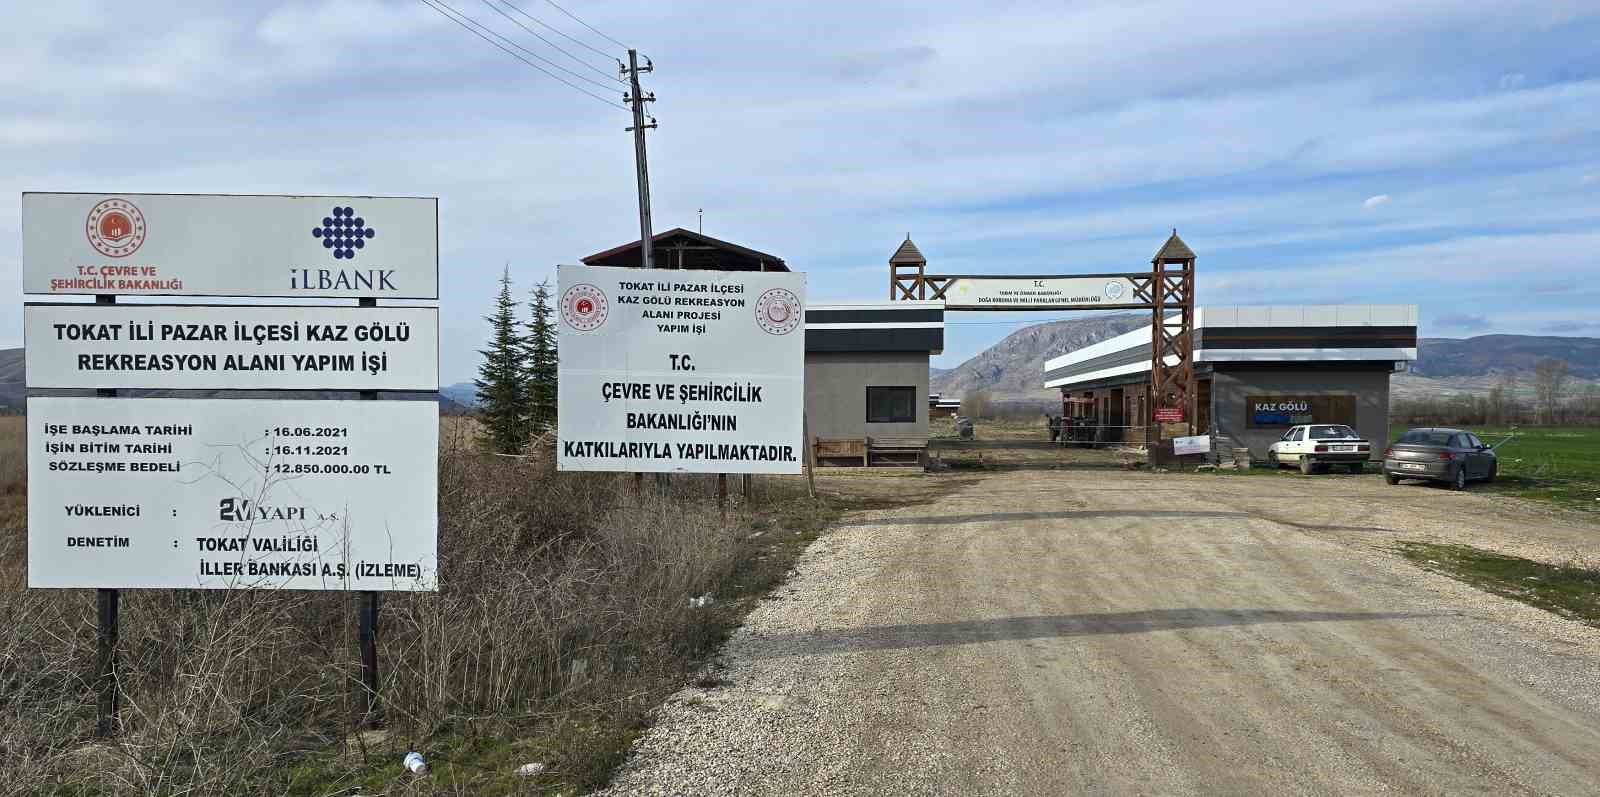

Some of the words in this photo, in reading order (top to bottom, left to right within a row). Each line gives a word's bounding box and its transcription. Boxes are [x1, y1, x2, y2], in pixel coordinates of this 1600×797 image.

[77, 266, 98, 276] T.C.
[100, 266, 138, 279] ÇEVRE
[140, 266, 156, 276] VE
[51, 277, 116, 291] ŞEHİRCİLİK
[119, 278, 183, 290] BAKANLIĞI
[619, 282, 654, 291] TOKAT
[658, 282, 670, 291] İLİ
[674, 284, 707, 292] PAZAR
[711, 283, 743, 295] İLÇESİ
[618, 296, 639, 304] KAZ
[643, 296, 671, 305] GÖLÜ
[675, 298, 744, 307] REKREASYON
[642, 310, 673, 318] ALANI
[677, 311, 720, 320] PROJESİ
[53, 324, 122, 340] TOKAT
[130, 321, 153, 340] İLİ
[161, 325, 227, 341] PAZAR
[235, 321, 299, 345] İLÇESİ
[307, 325, 348, 341] KAZ
[355, 322, 409, 341] GÖLÜ
[657, 325, 689, 333] YAPIM
[693, 324, 705, 335] İŞİ
[78, 354, 216, 370] REKREASYON
[224, 355, 284, 370] ALANI
[291, 355, 354, 371] YAPIM
[362, 351, 386, 375] İŞİ
[669, 354, 695, 370] T.C.
[602, 383, 650, 402] ÇEVRE
[656, 384, 674, 400] VE
[680, 381, 762, 404] ŞEHİRCİLİK
[1255, 403, 1276, 411] KAZ
[1279, 400, 1307, 411] GÖLÜ
[45, 423, 67, 436] İŞE
[73, 425, 141, 436] BAŞLAMA
[145, 424, 192, 435] TARİHİ
[274, 427, 346, 437] 16.06.2021
[46, 442, 74, 455] İŞİN
[80, 442, 119, 453] BİTİM
[124, 443, 171, 453] TARİHİ
[275, 446, 348, 456] 16.11.2021
[563, 440, 672, 458] KATKILARIYLA
[677, 443, 796, 461] YAPILMAKTADIR.
[49, 460, 125, 473] SÖZLEŞME
[130, 461, 180, 472] BEDELİ
[274, 465, 369, 474] 12.850.000.00
[374, 465, 391, 474] TL
[65, 504, 139, 516] YÜKLENİCİ
[259, 508, 305, 520] YAPI
[67, 536, 129, 547] DENETİM
[197, 538, 248, 552] TOKAT
[253, 537, 318, 552] VALİLİĞİ
[200, 562, 243, 576] İLLER
[249, 564, 316, 576] BANKASI
[355, 563, 421, 581] (İZLEME)
